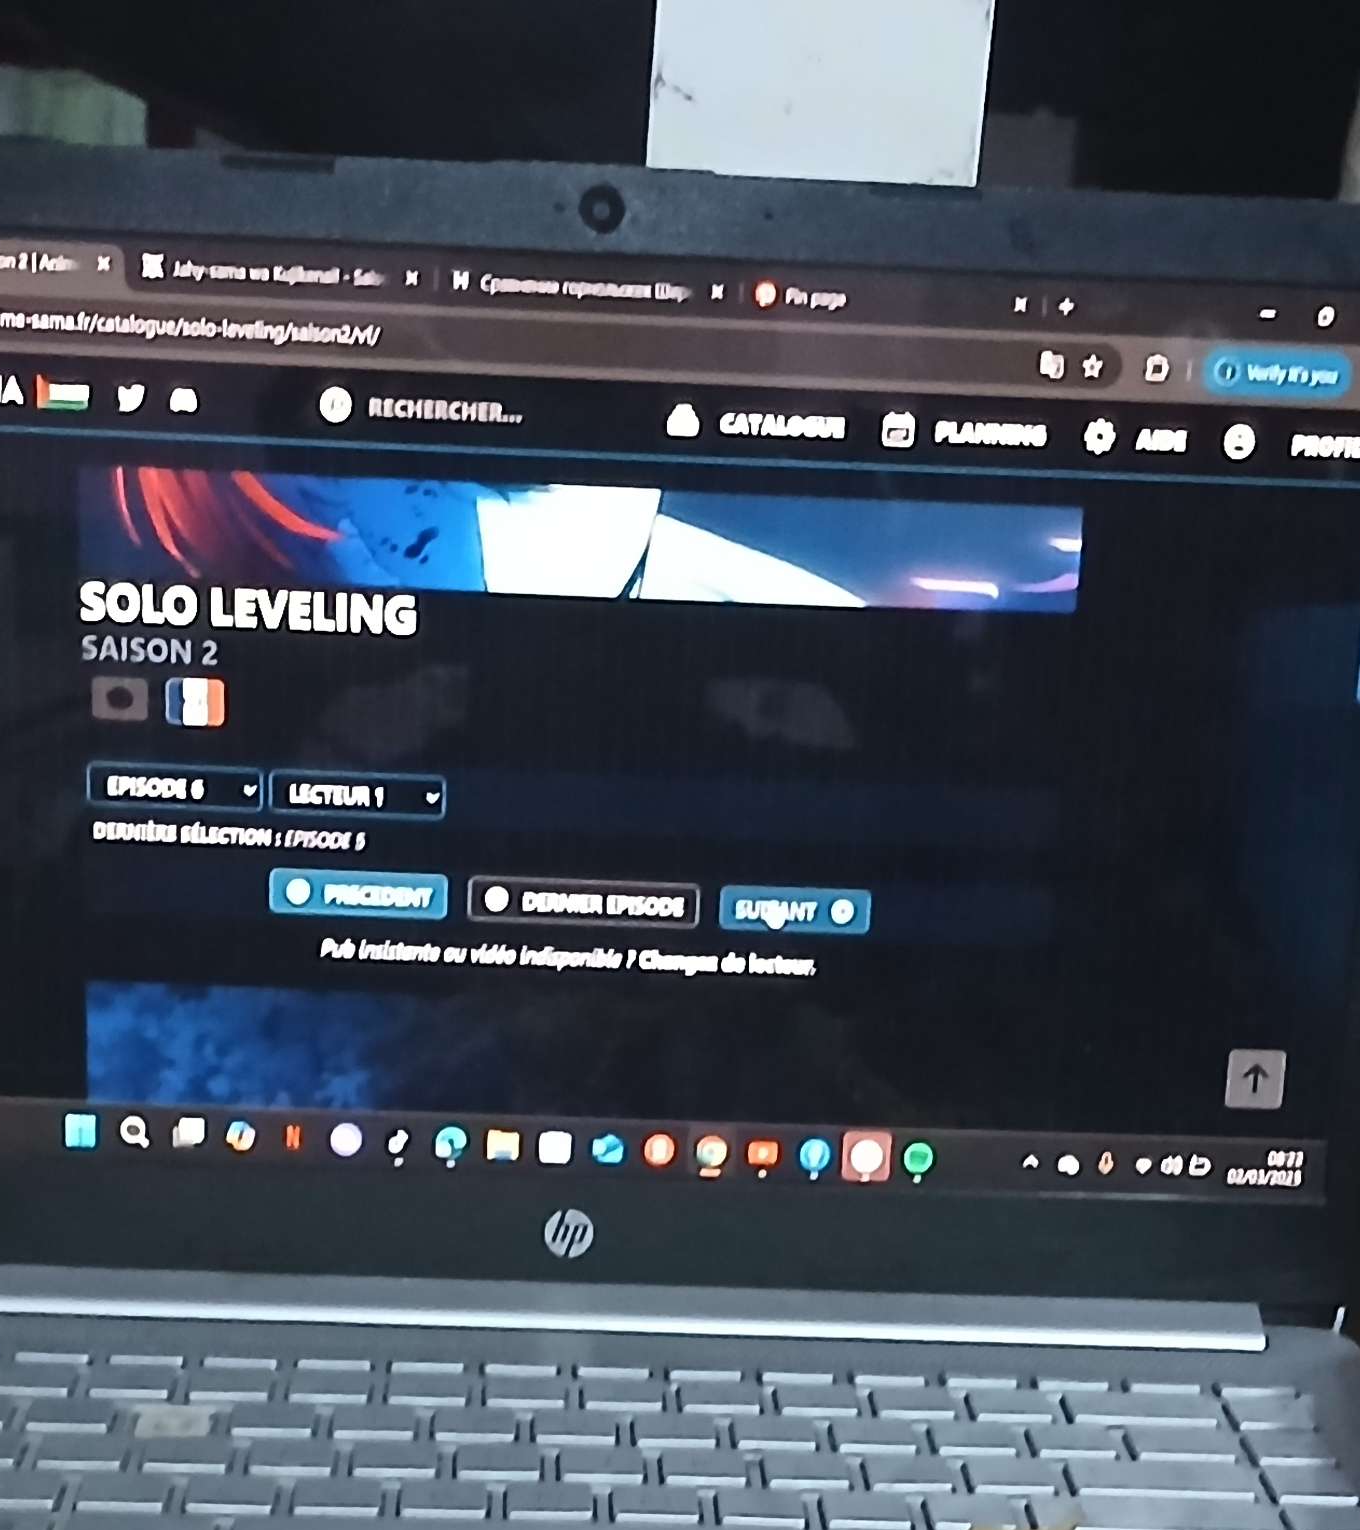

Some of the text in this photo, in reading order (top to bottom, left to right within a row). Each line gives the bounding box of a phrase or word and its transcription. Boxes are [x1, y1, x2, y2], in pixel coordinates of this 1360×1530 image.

[1248, 364, 1289, 385] Verify
[1309, 370, 1338, 386] you
[369, 397, 522, 423] RECHERCHER...
[720, 413, 845, 438] CATALOGUE
[935, 421, 1047, 446] PLANNING
[1136, 429, 1187, 452] AIDE
[80, 581, 417, 635] SOLO LEVELING
[82, 635, 217, 665] SAISON 2
[107, 776, 187, 799] EPISODE
[290, 784, 384, 807] LECTEUR 1
[522, 892, 603, 914] DERNIER
[320, 938, 355, 959] Pub
[444, 947, 467, 963] ou
[721, 954, 746, 973] de
[546, 1209, 593, 1258] hp
